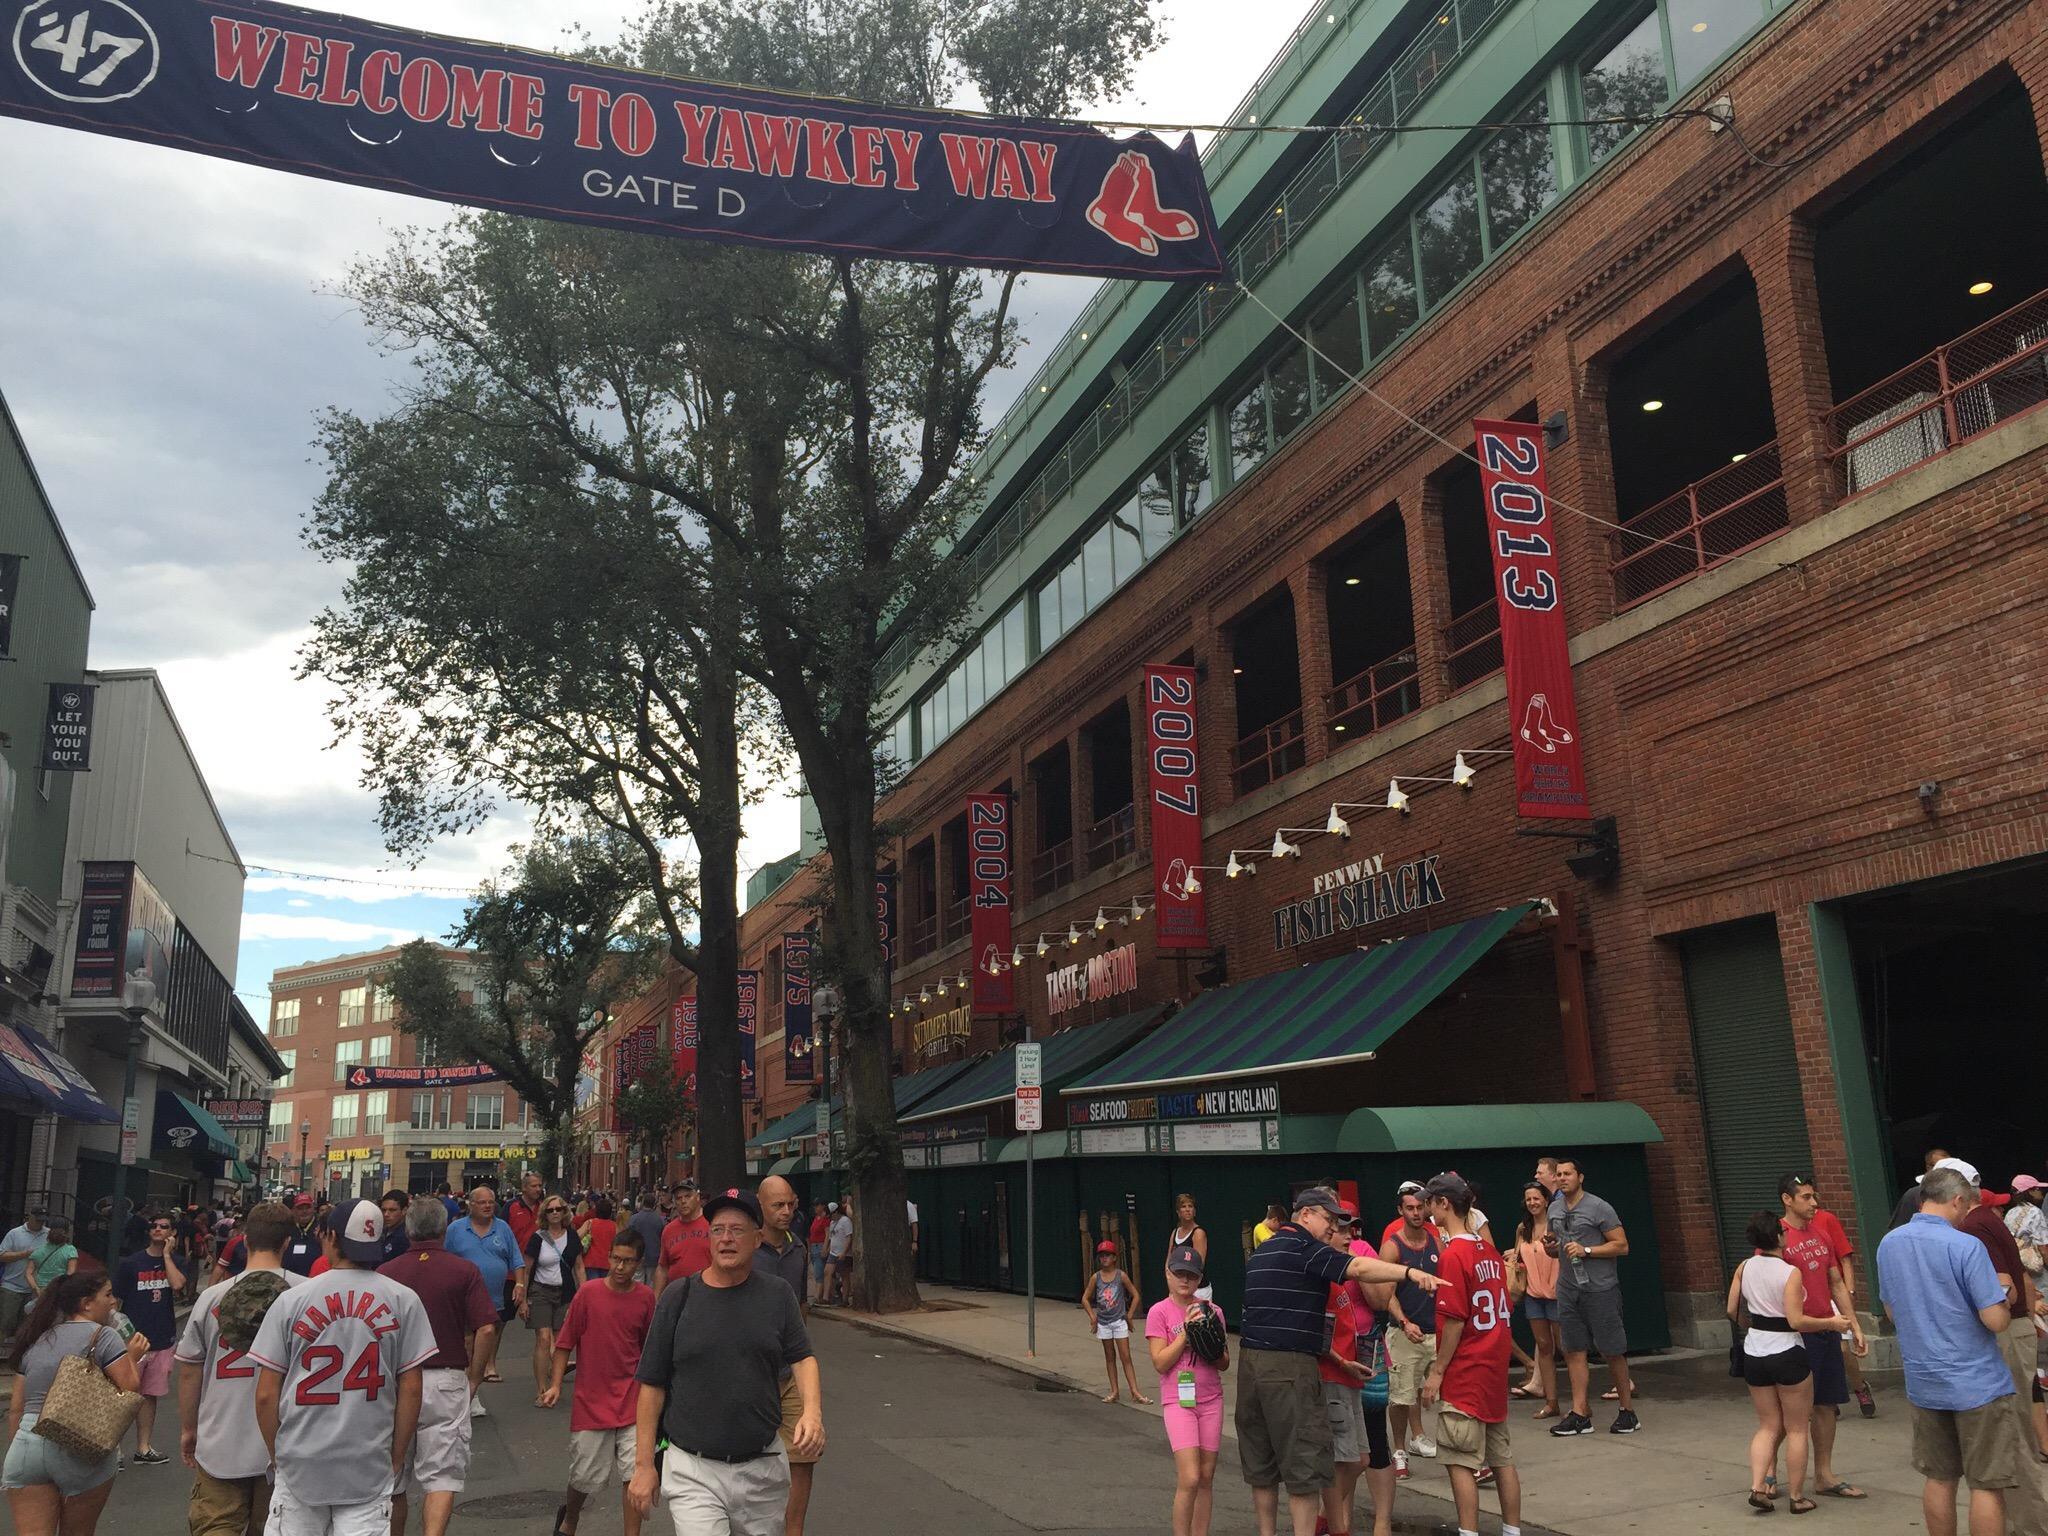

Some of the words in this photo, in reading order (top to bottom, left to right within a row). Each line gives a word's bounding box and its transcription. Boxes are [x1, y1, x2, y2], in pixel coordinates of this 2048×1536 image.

[210, 15, 545, 140] WELCOME
[567, 83, 657, 157] TO
[674, 100, 925, 192] YAWKEY
[939, 132, 1058, 204] WAY
[582, 168, 698, 211] GATE
[718, 188, 746, 218] D
[1482, 433, 1558, 611] 2013
[51, 724, 87, 736] YOUR
[57, 711, 82, 722] LET
[52, 751, 83, 762] OUT.
[55, 737, 81, 748] YOU
[1150, 674, 1198, 816] 2007
[971, 801, 1009, 909] 2004
[1313, 853, 1385, 894] FENWAY
[1272, 892, 1334, 951] FISH
[1338, 854, 1446, 931] SHACK
[786, 936, 811, 1006] 1975
[1046, 963, 1080, 1016] TASTE
[1087, 942, 1137, 1003] BOSTON
[737, 974, 756, 1035] 1967
[913, 1013, 948, 1053] SUMMER
[948, 1004, 971, 1037] TIME
[928, 1037, 949, 1058] GRILL
[375, 1068, 421, 1080] WELCOME
[423, 1069, 437, 1079] TO
[440, 1066, 477, 1078] YAWKEY
[239, 1100, 264, 1114] SOX
[1089, 1100, 1128, 1122] SEAFOOD
[1205, 1090, 1226, 1115] NEW
[1228, 1087, 1278, 1113] ENGLAND
[328, 1150, 345, 1161] BEER
[346, 1148, 370, 1159] WORKS
[430, 1148, 470, 1159] BOSTON
[475, 1148, 500, 1159] BEER
[137, 1279, 170, 1291] BASEBA
[292, 1290, 400, 1343] RAMIREZ
[1472, 1287, 1511, 1331] 34
[295, 1341, 386, 1406] 24
